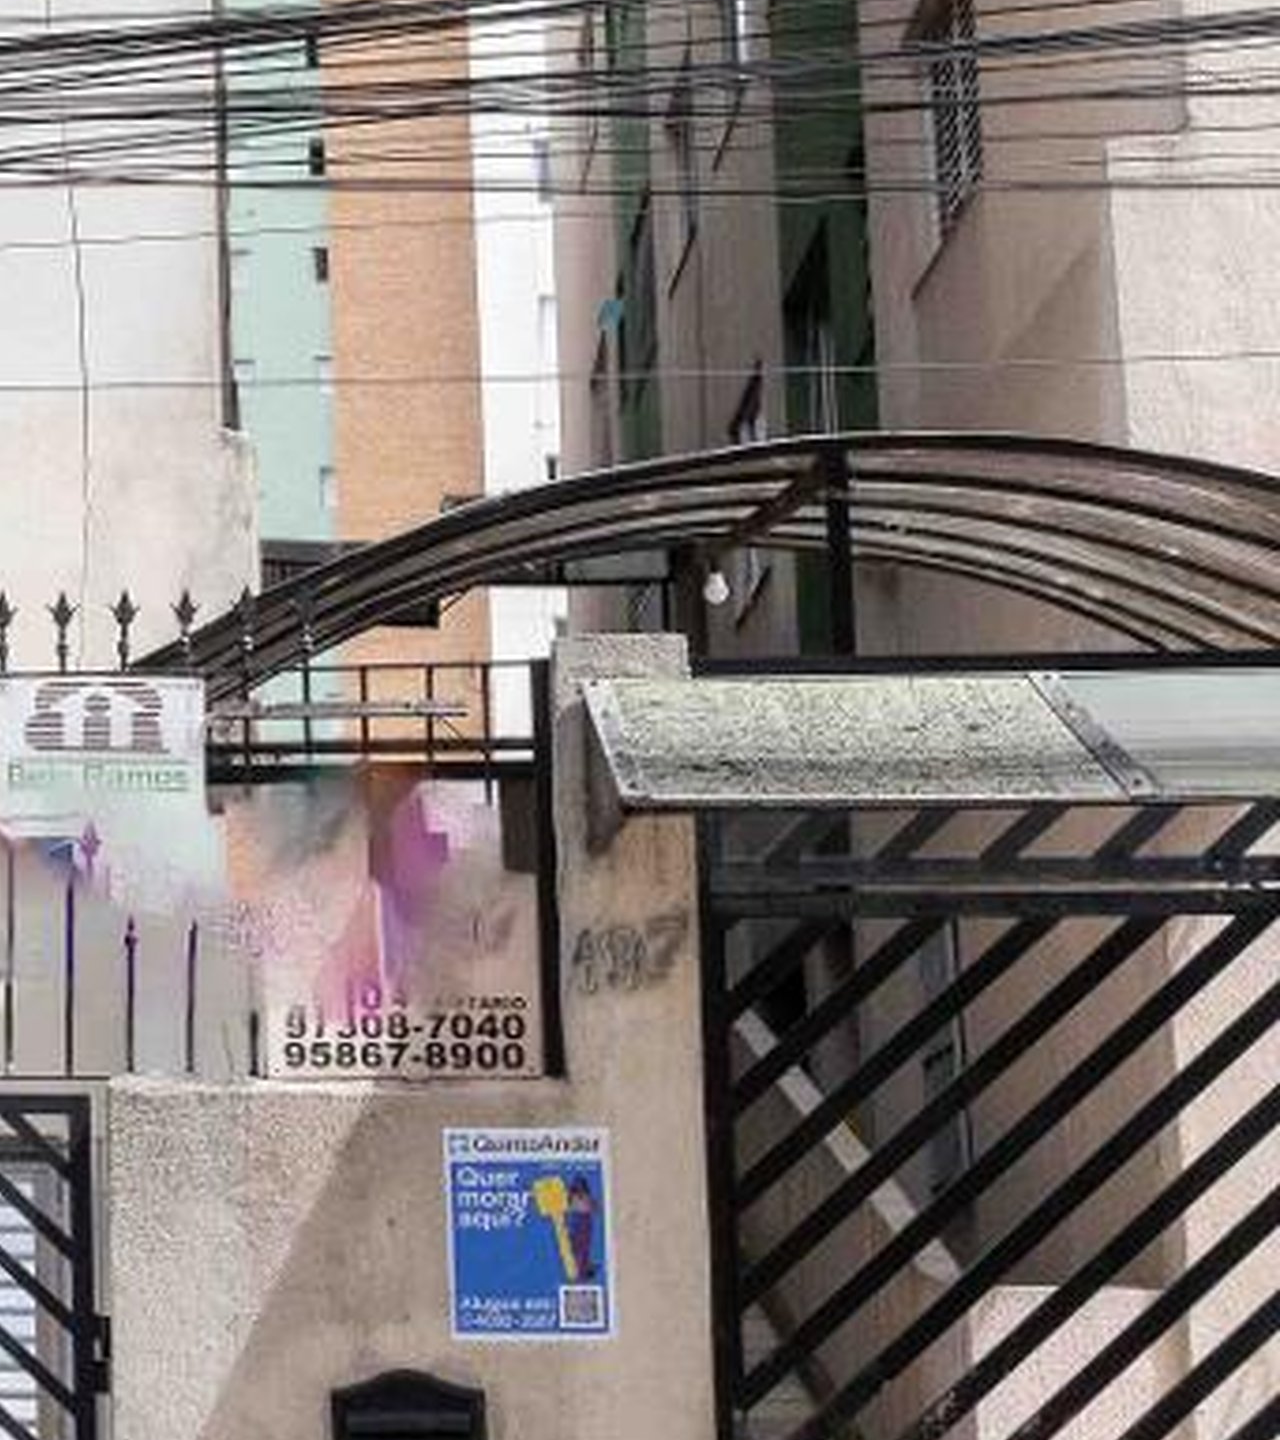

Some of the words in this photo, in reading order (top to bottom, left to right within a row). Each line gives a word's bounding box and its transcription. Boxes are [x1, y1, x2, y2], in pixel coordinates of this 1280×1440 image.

[284, 1042, 525, 1069] 95867-8900
[456, 1166, 520, 1188] Quer
[457, 1190, 530, 1208] morar
